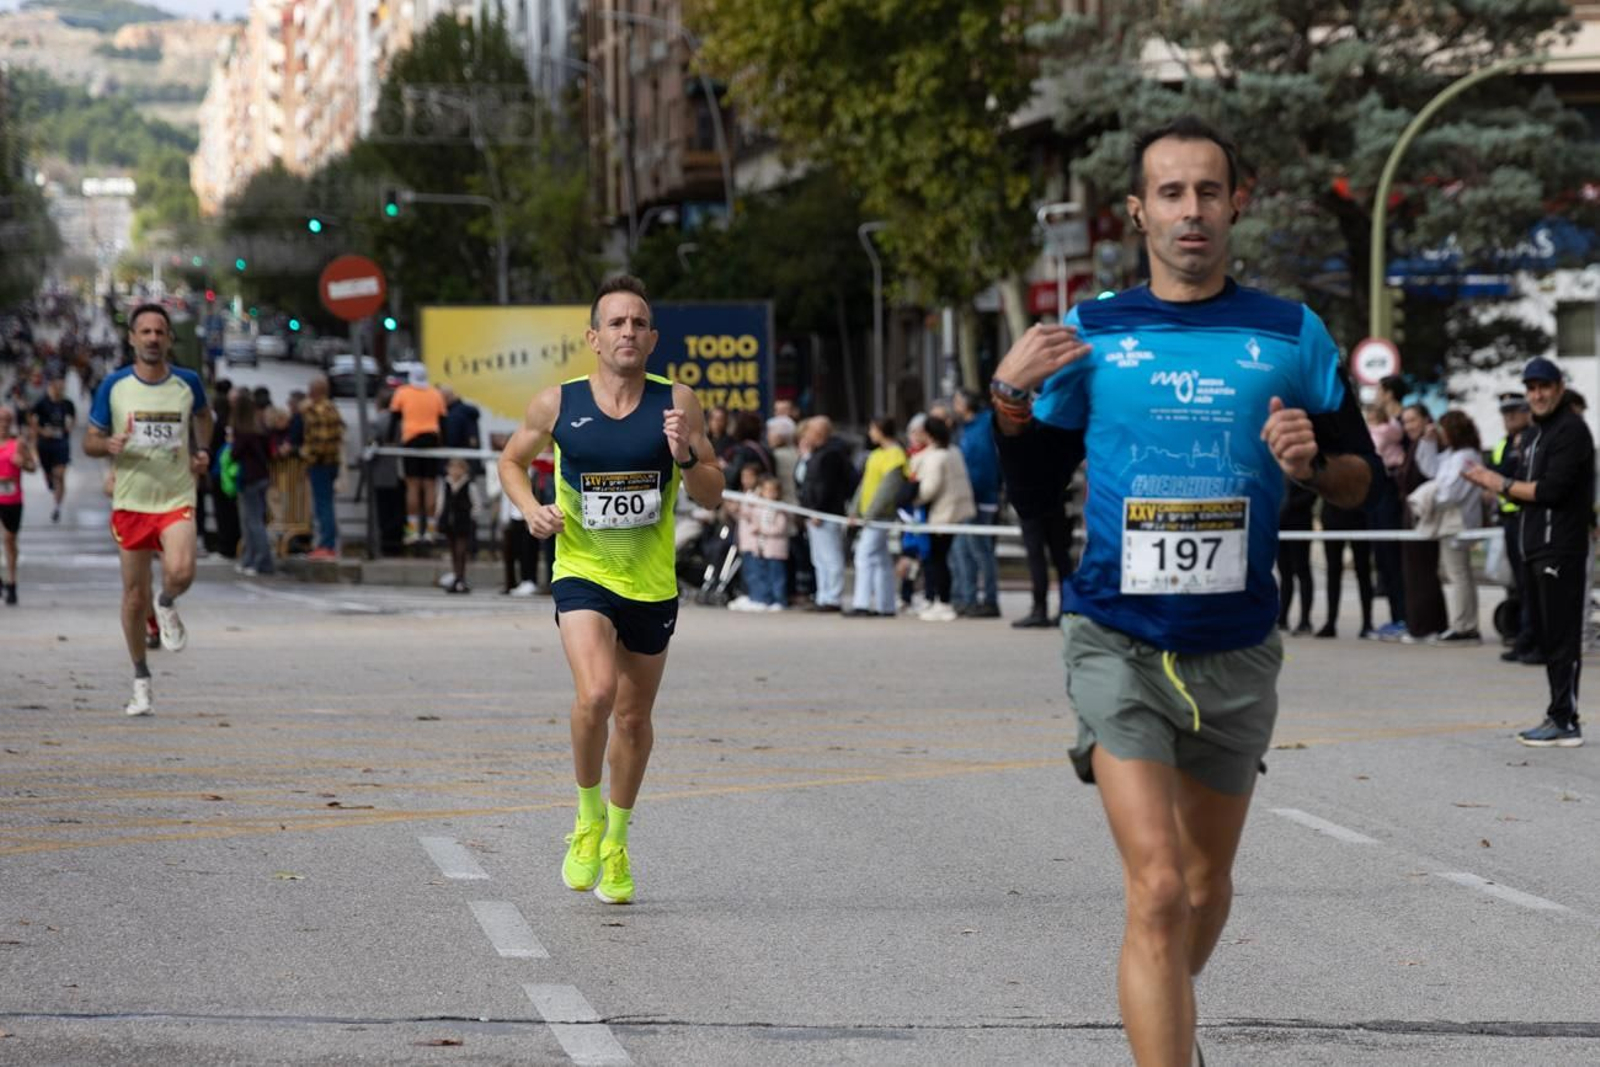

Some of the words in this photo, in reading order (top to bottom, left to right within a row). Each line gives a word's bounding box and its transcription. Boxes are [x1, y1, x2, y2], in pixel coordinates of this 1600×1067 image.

[684, 334, 759, 359] TODO
[443, 349, 529, 376] Gran
[667, 361, 701, 386] LO
[706, 361, 759, 387] QUE
[143, 424, 172, 439] 453
[597, 494, 645, 516] 760
[1128, 503, 1157, 521] XXV
[1151, 537, 1224, 572] 197
